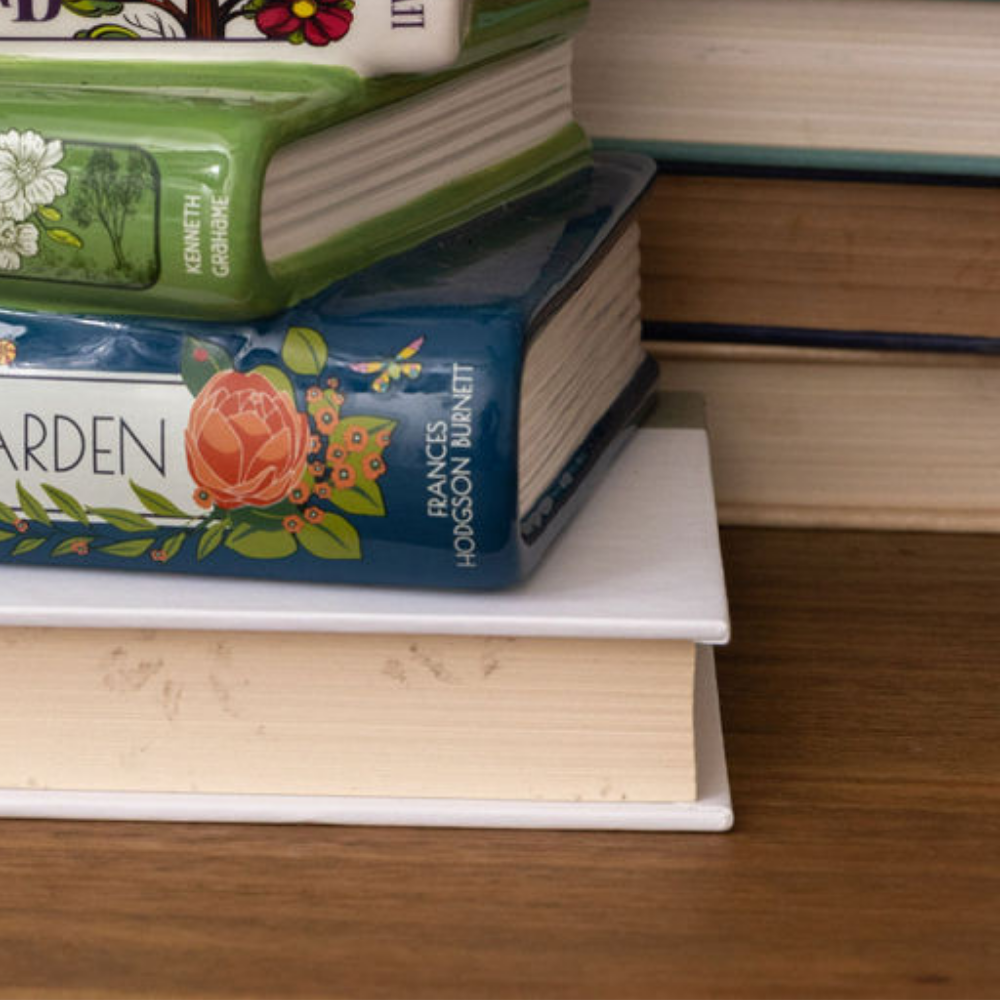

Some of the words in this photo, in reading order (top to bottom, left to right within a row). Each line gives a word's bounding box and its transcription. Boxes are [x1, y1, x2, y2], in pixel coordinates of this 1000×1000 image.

[183, 194, 202, 275] KENNETH
[451, 362, 474, 449] BURNETT
[426, 419, 448, 519] FRANCES
[451, 456, 477, 568] HODGSON
